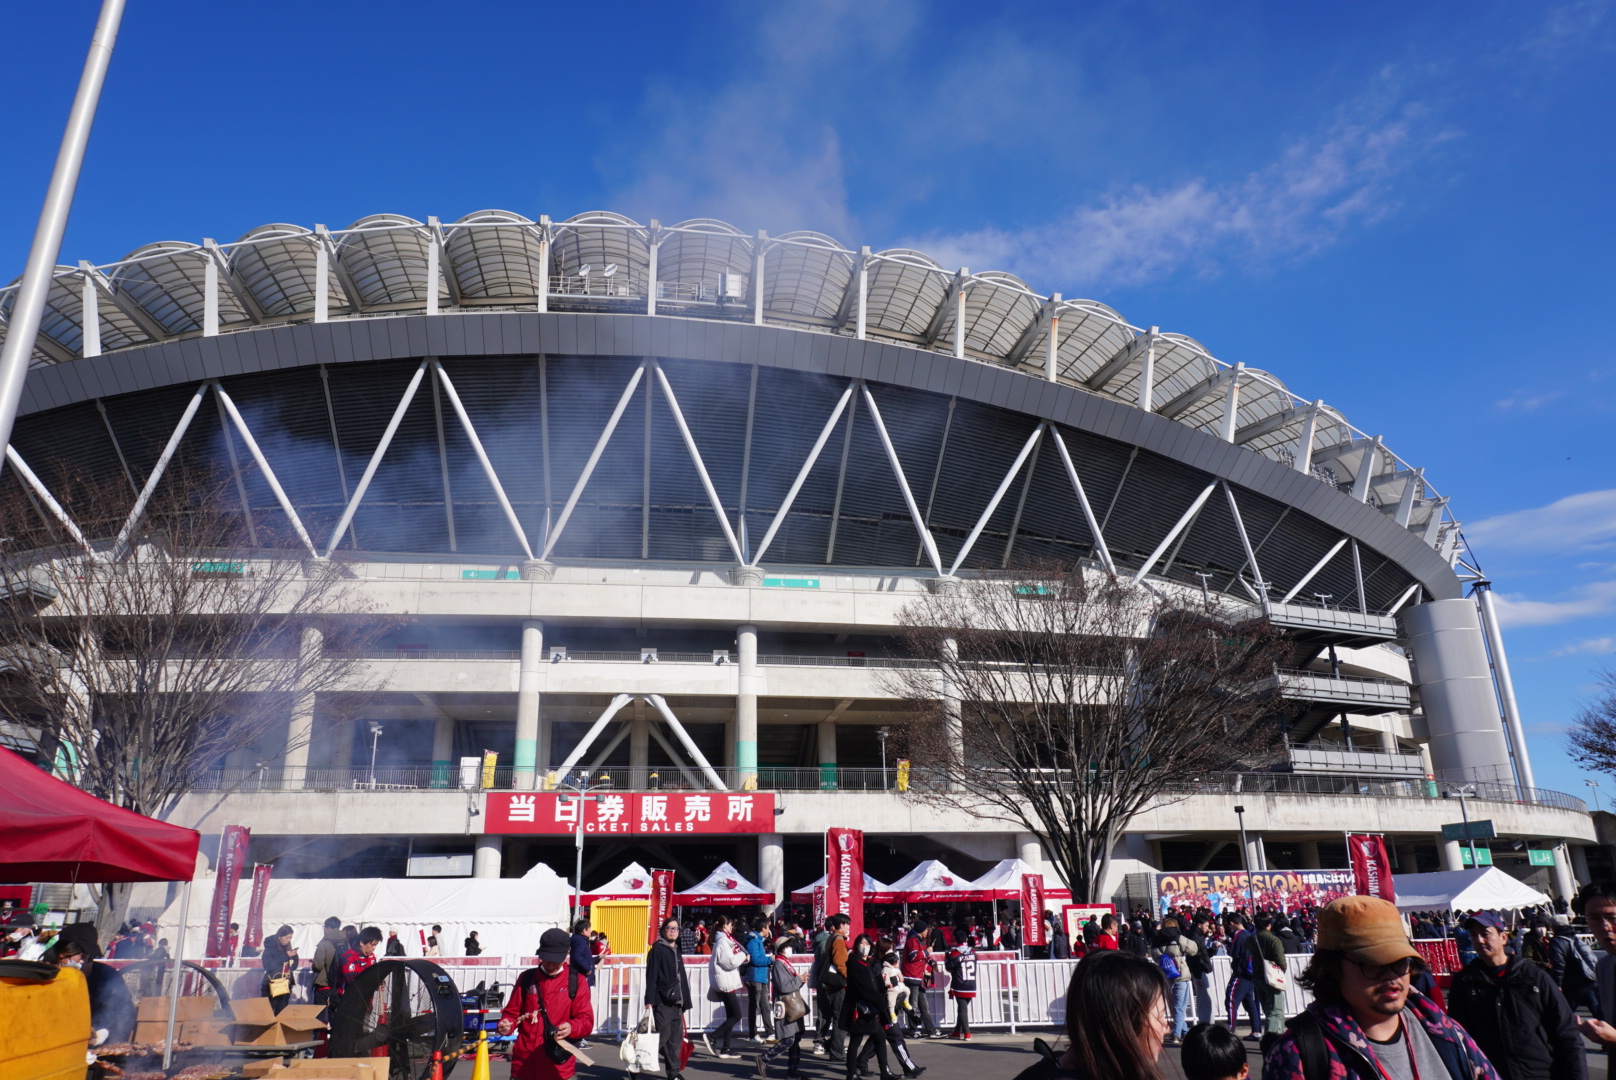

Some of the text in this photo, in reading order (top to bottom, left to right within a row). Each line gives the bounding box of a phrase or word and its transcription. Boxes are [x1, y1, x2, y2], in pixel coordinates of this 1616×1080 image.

[508, 795, 754, 823] 当日券販売所
[567, 822, 695, 832] TCKET SALES
[839, 853, 851, 899] KASHIMA
[1160, 874, 1304, 894] ONE MISSION
[658, 887, 667, 916] KASHIMA
[1030, 888, 1039, 943] KASHIMA ANTLERS
[960, 961, 976, 981] 12
